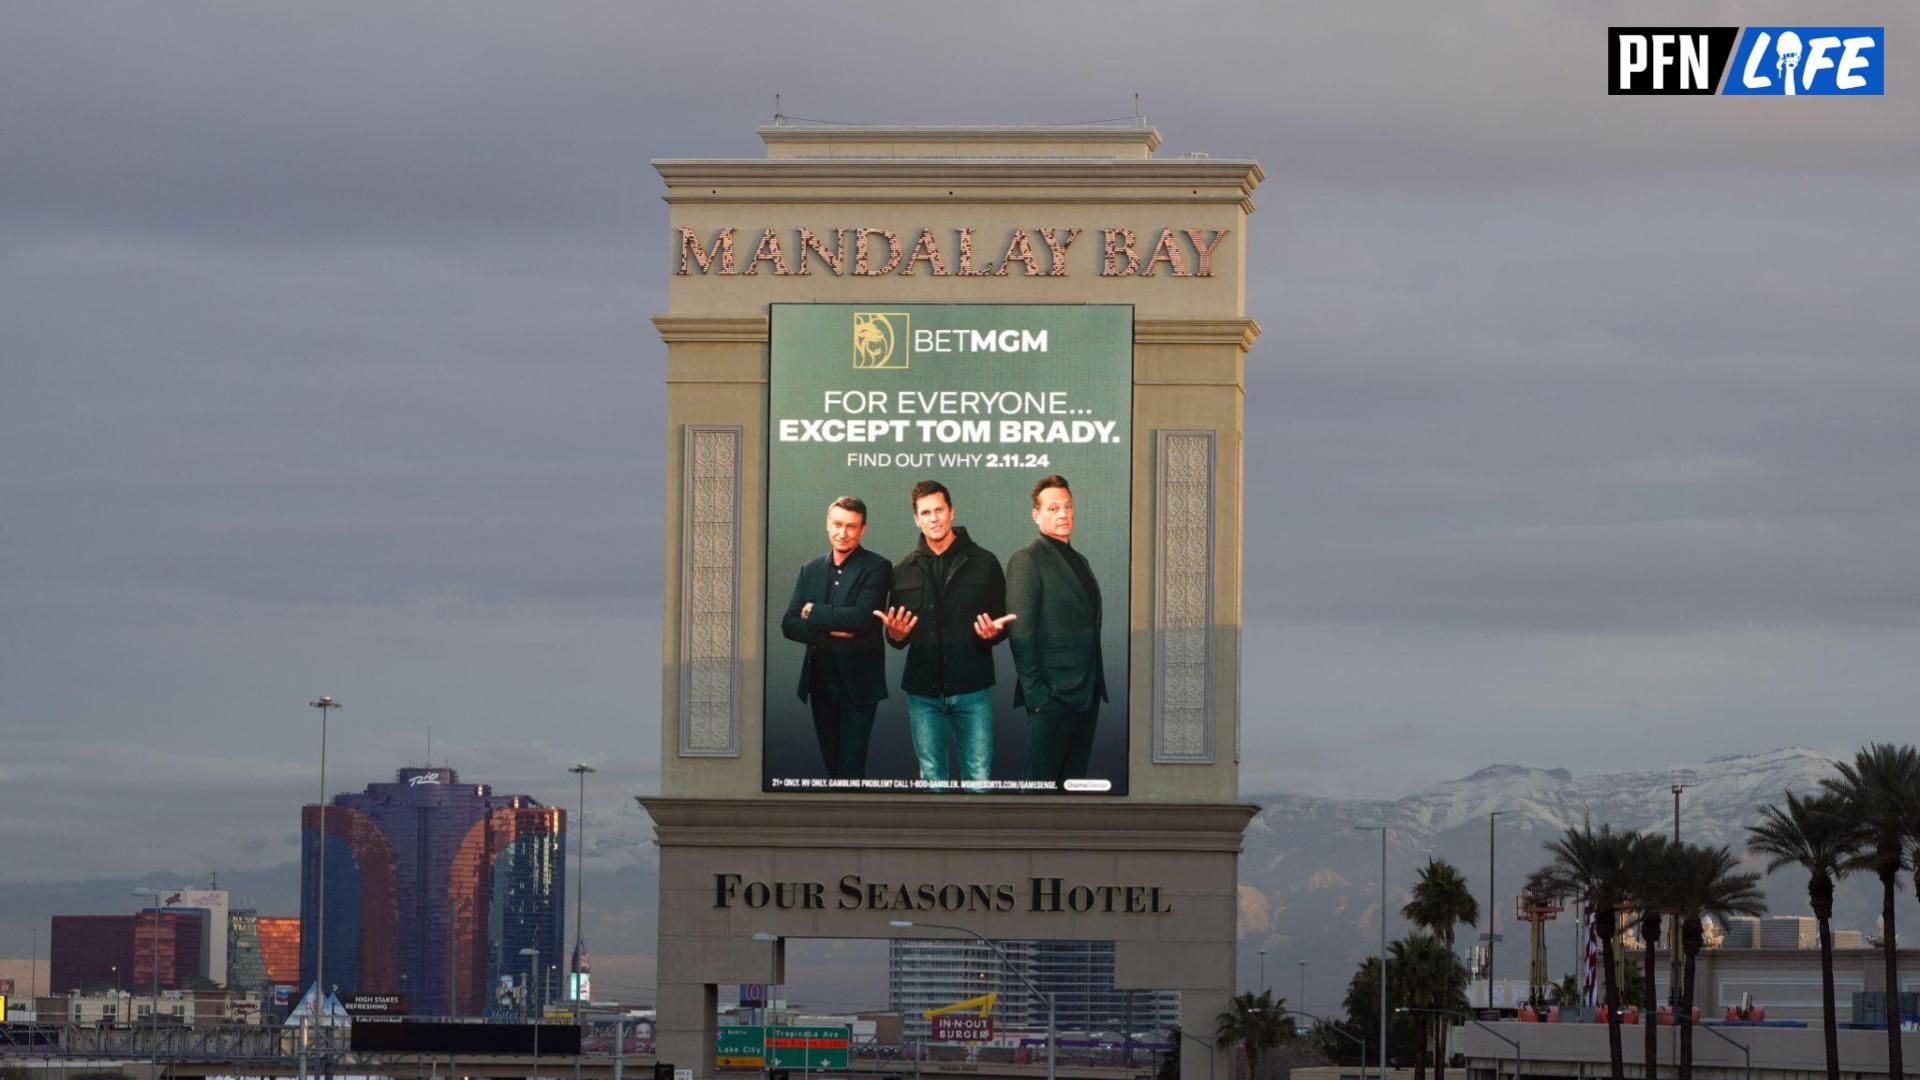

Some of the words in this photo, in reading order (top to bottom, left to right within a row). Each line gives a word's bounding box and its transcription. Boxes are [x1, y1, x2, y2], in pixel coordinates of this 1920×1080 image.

[676, 225, 1083, 277] MANDALAY
[1099, 226, 1231, 277] BAY
[914, 329, 1049, 352] BETMGM
[824, 390, 888, 414] FOR
[897, 391, 1093, 415] EVERYONE...
[779, 419, 910, 443] EXCEPT
[916, 420, 991, 443] TOM
[999, 420, 1121, 443] BRADY.
[847, 453, 892, 467] FIND
[895, 453, 935, 467] OUT
[938, 453, 983, 467] WHY
[985, 453, 1050, 468] 2.11.24
[829, 779, 860, 787] GAMBLING
[894, 779, 909, 788] CALL
[939, 1029, 989, 1039] BURGER
[718, 1045, 739, 1053] Lake
[742, 1045, 761, 1055] City
